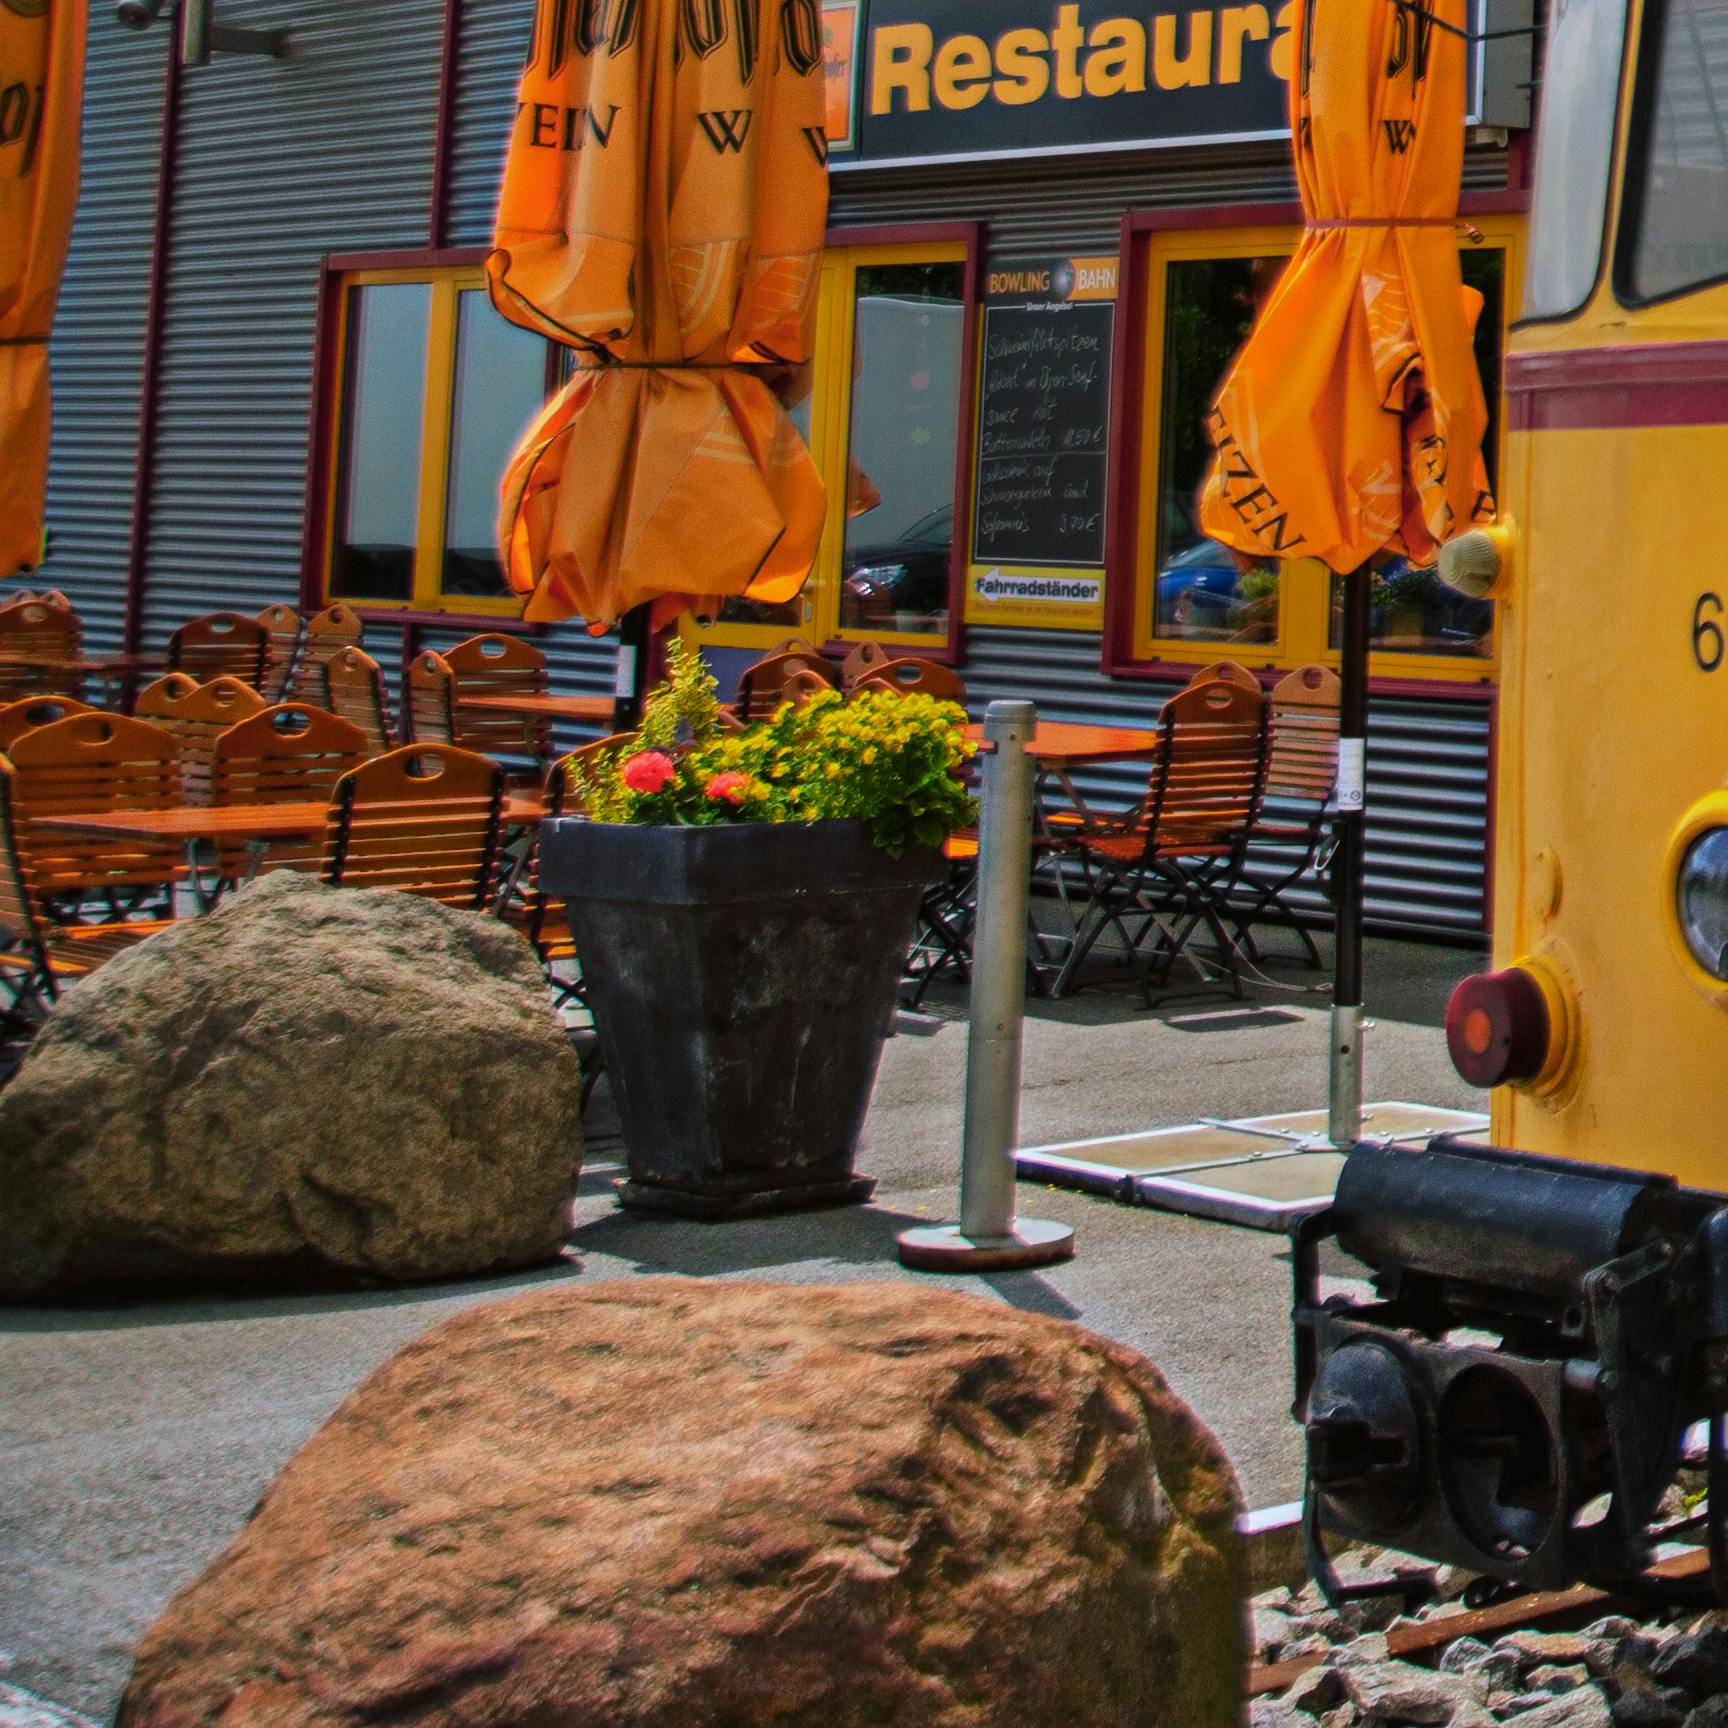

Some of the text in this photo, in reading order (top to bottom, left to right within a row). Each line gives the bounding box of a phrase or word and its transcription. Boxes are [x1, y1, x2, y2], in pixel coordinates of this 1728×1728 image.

[989, 268, 1116, 294] BOWLING BAHN
[976, 577, 1099, 598] Fahrradständer
